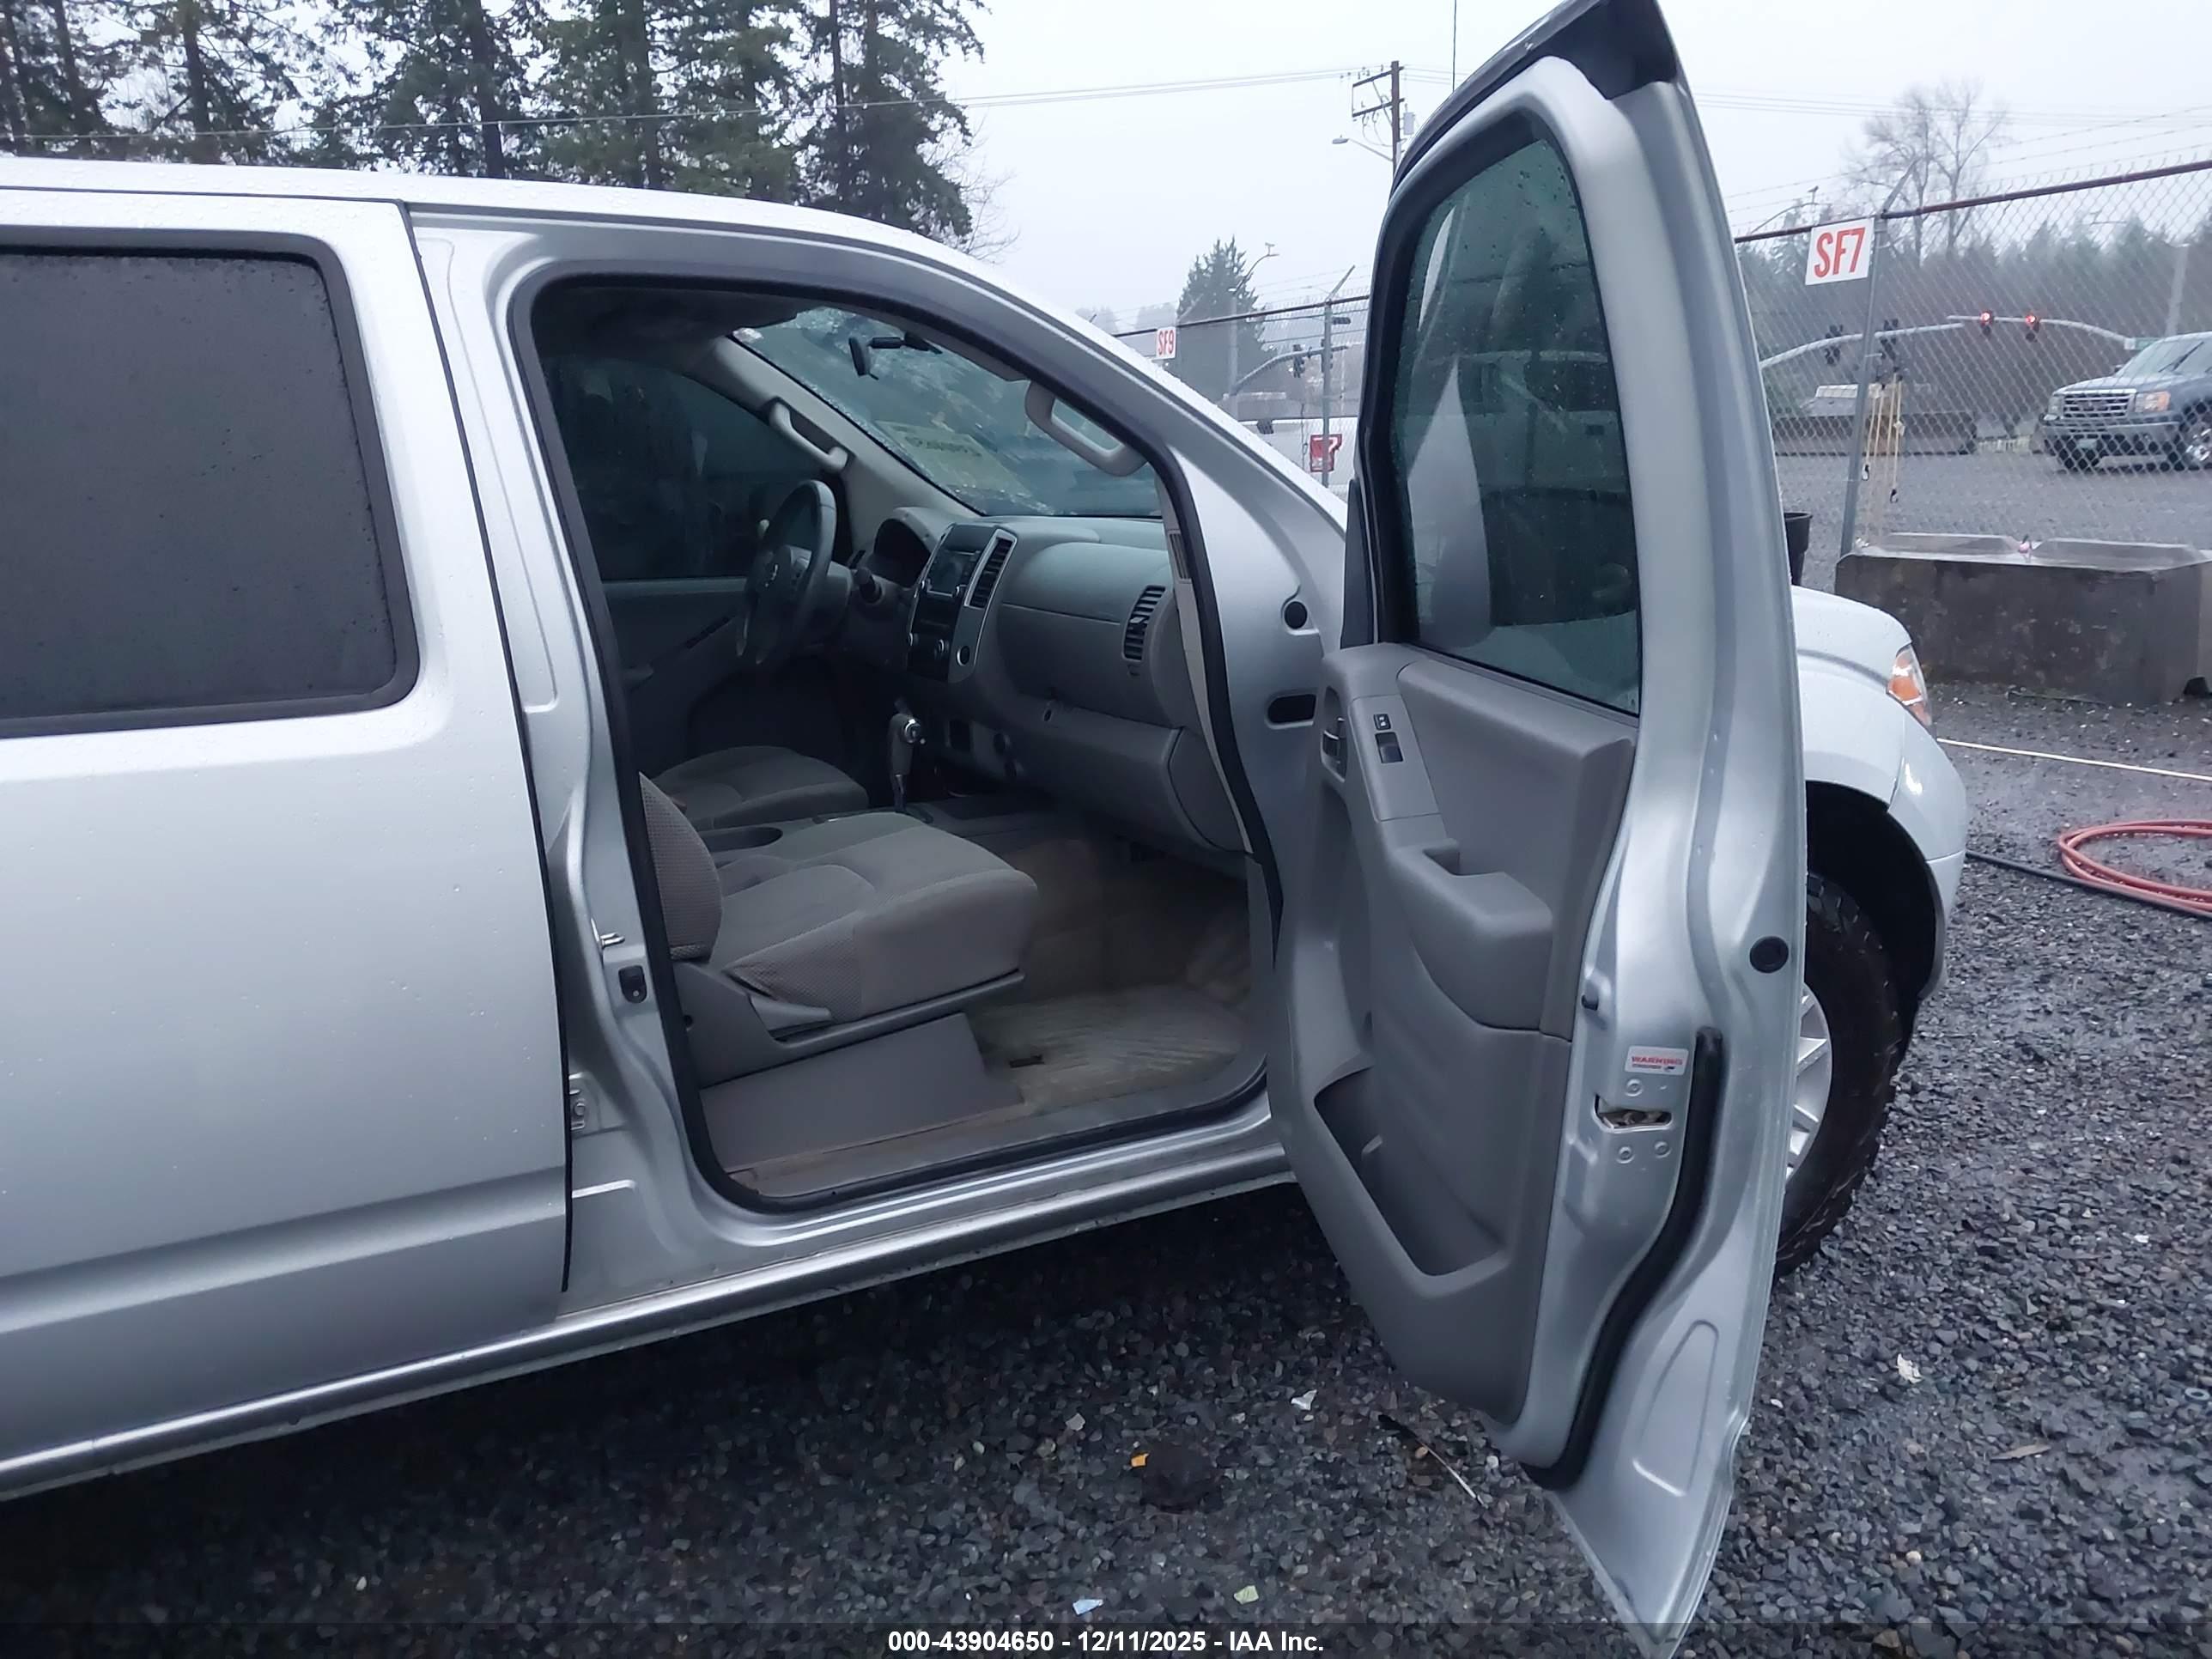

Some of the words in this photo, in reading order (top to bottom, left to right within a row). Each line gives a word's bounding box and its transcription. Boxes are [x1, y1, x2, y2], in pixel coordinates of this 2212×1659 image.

[1814, 227, 1866, 278] SF7
[1158, 330, 1175, 356] SF9
[1632, 1055, 1683, 1066] WARNING
